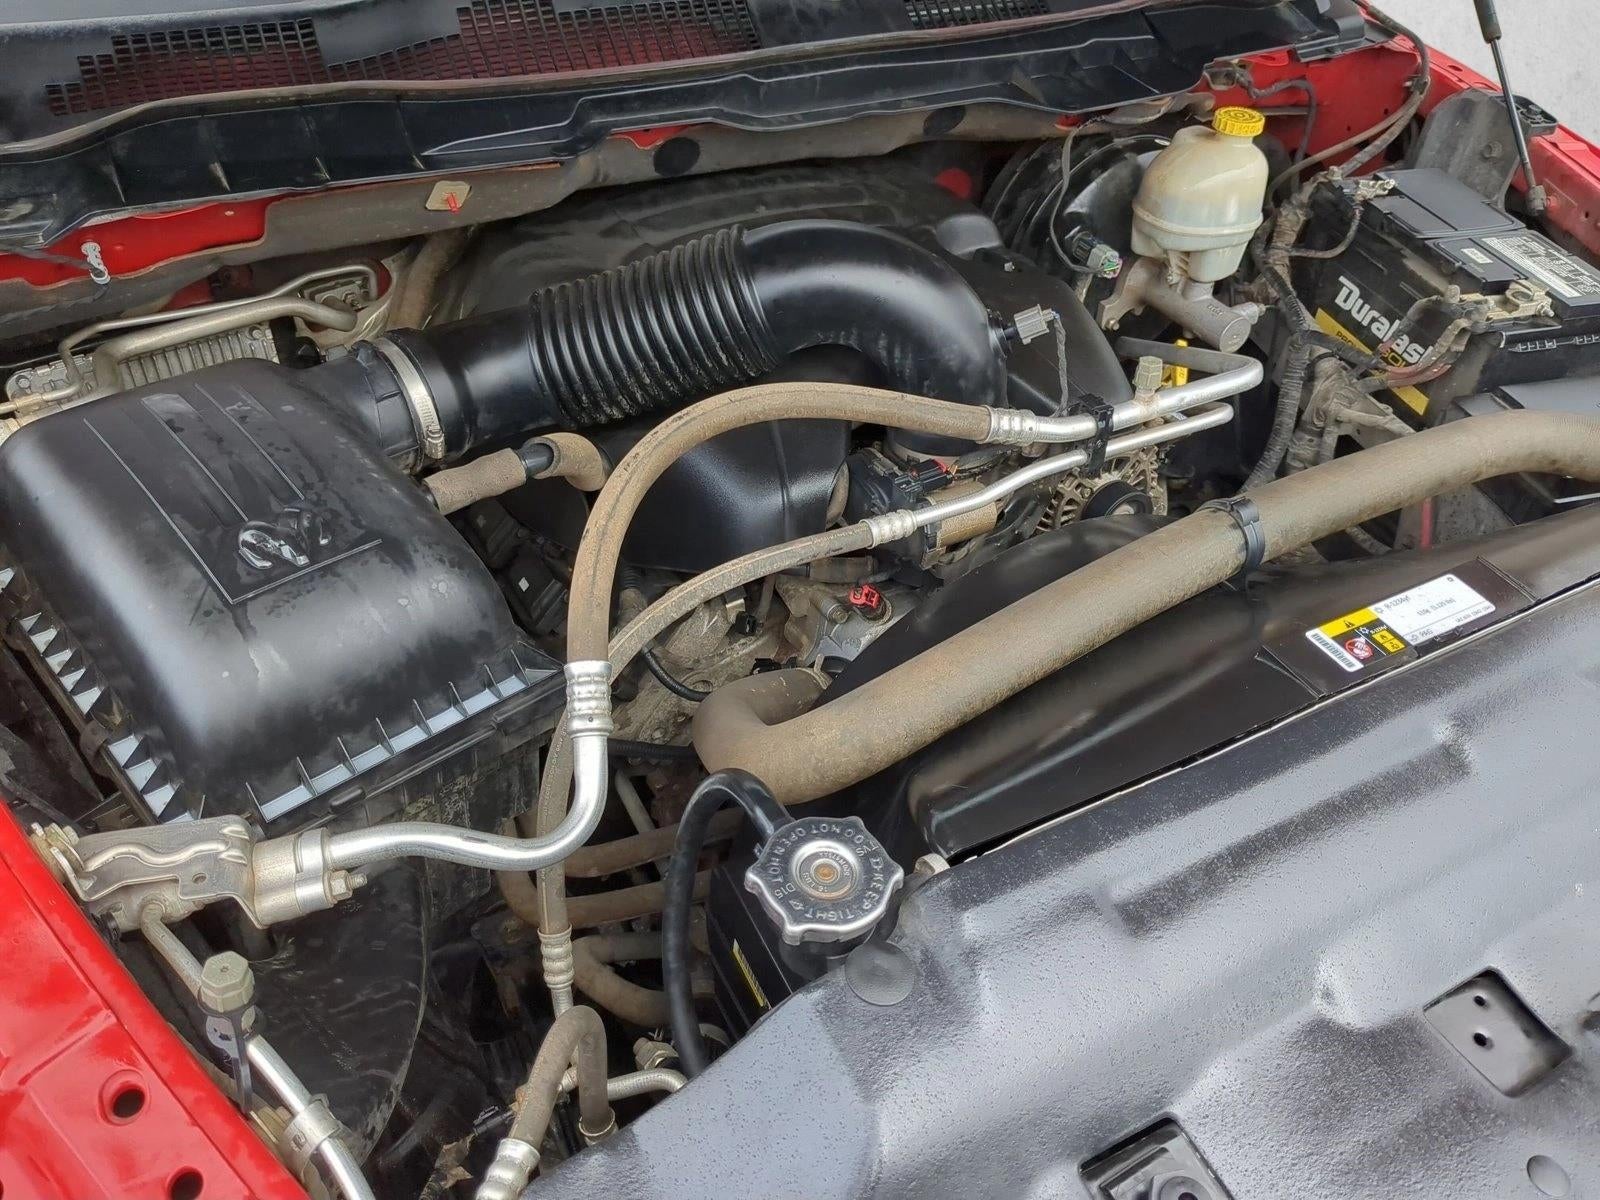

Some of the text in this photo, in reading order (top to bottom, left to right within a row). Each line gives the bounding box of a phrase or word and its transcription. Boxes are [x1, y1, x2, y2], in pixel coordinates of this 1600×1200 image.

[809, 823, 842, 834] NOT
[774, 827, 807, 855] OPEN
[774, 882, 796, 900] D15
[805, 908, 855, 922] TIGHT
